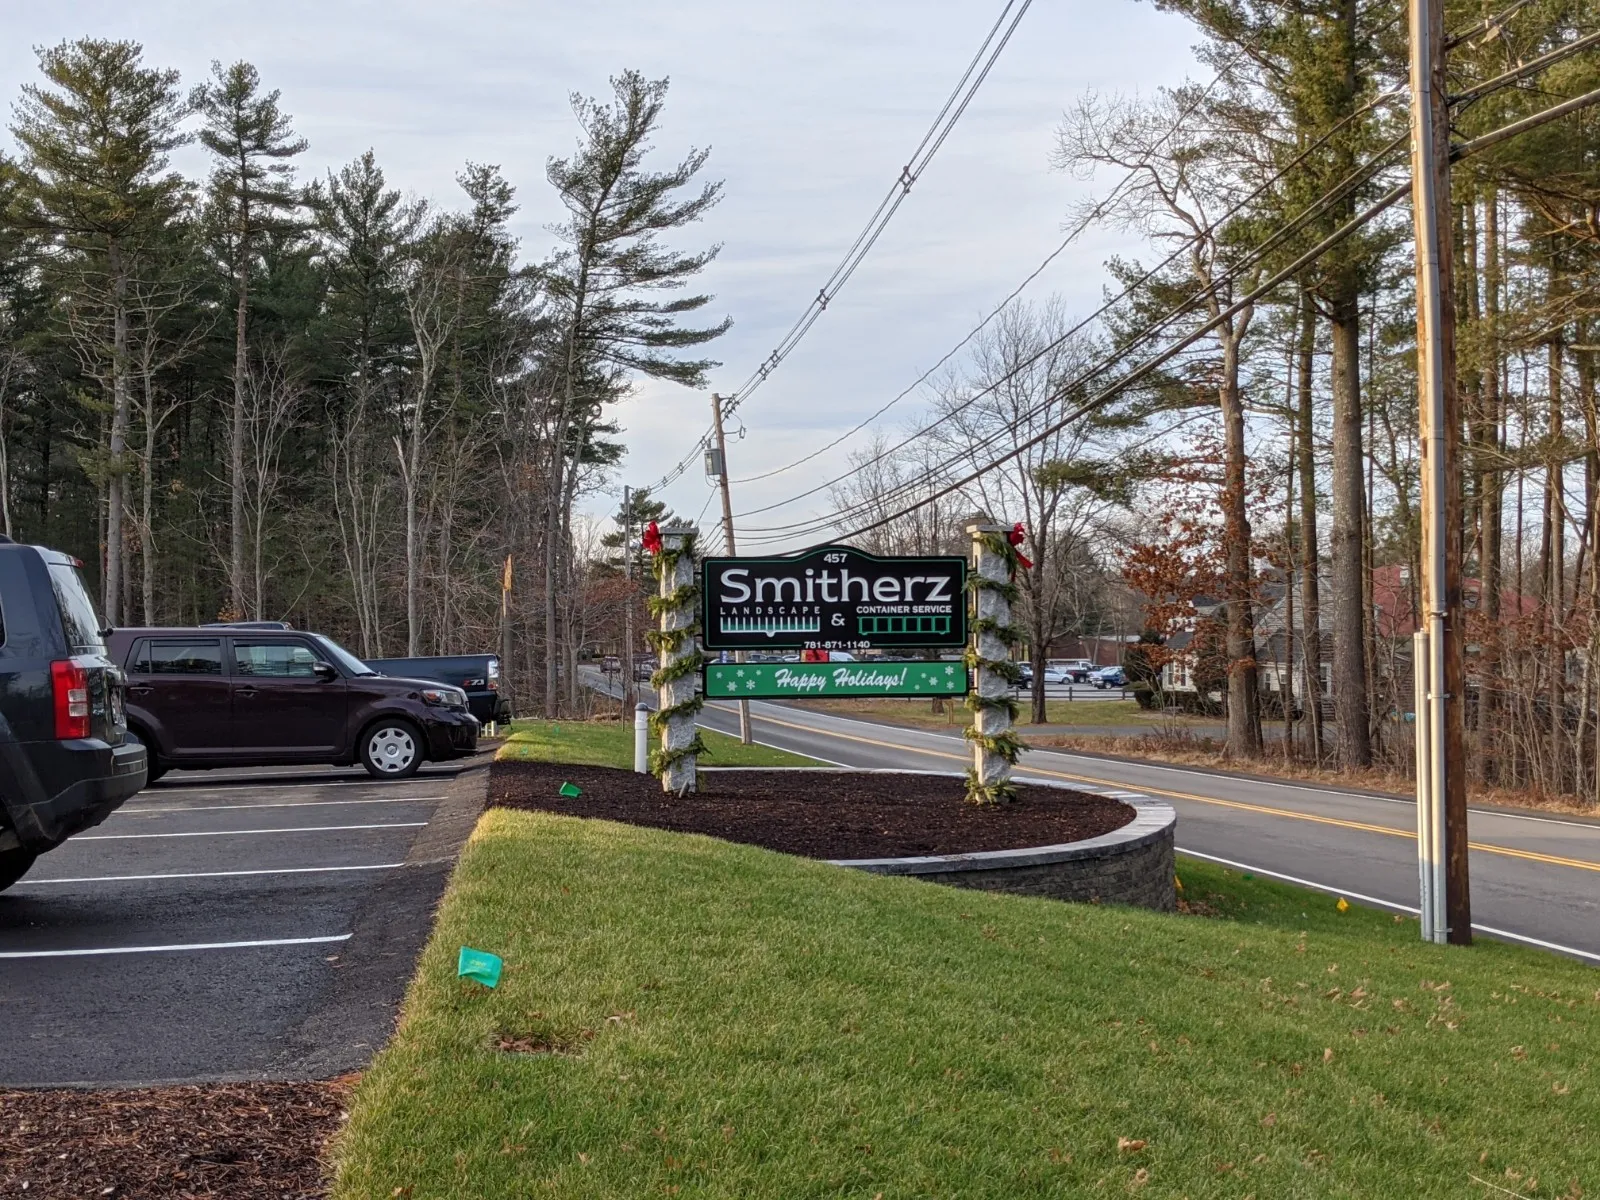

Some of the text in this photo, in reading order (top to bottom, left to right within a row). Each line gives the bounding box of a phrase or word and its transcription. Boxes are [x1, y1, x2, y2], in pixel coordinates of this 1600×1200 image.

[823, 553, 848, 563] 457
[720, 567, 952, 604] Smitherz
[720, 606, 820, 615] LANDSCAPE
[856, 605, 952, 614] CONTAINER SERVICE
[831, 613, 846, 626] &
[804, 640, 871, 649] 781-871-1140
[774, 667, 908, 692] Happy Holidays!
